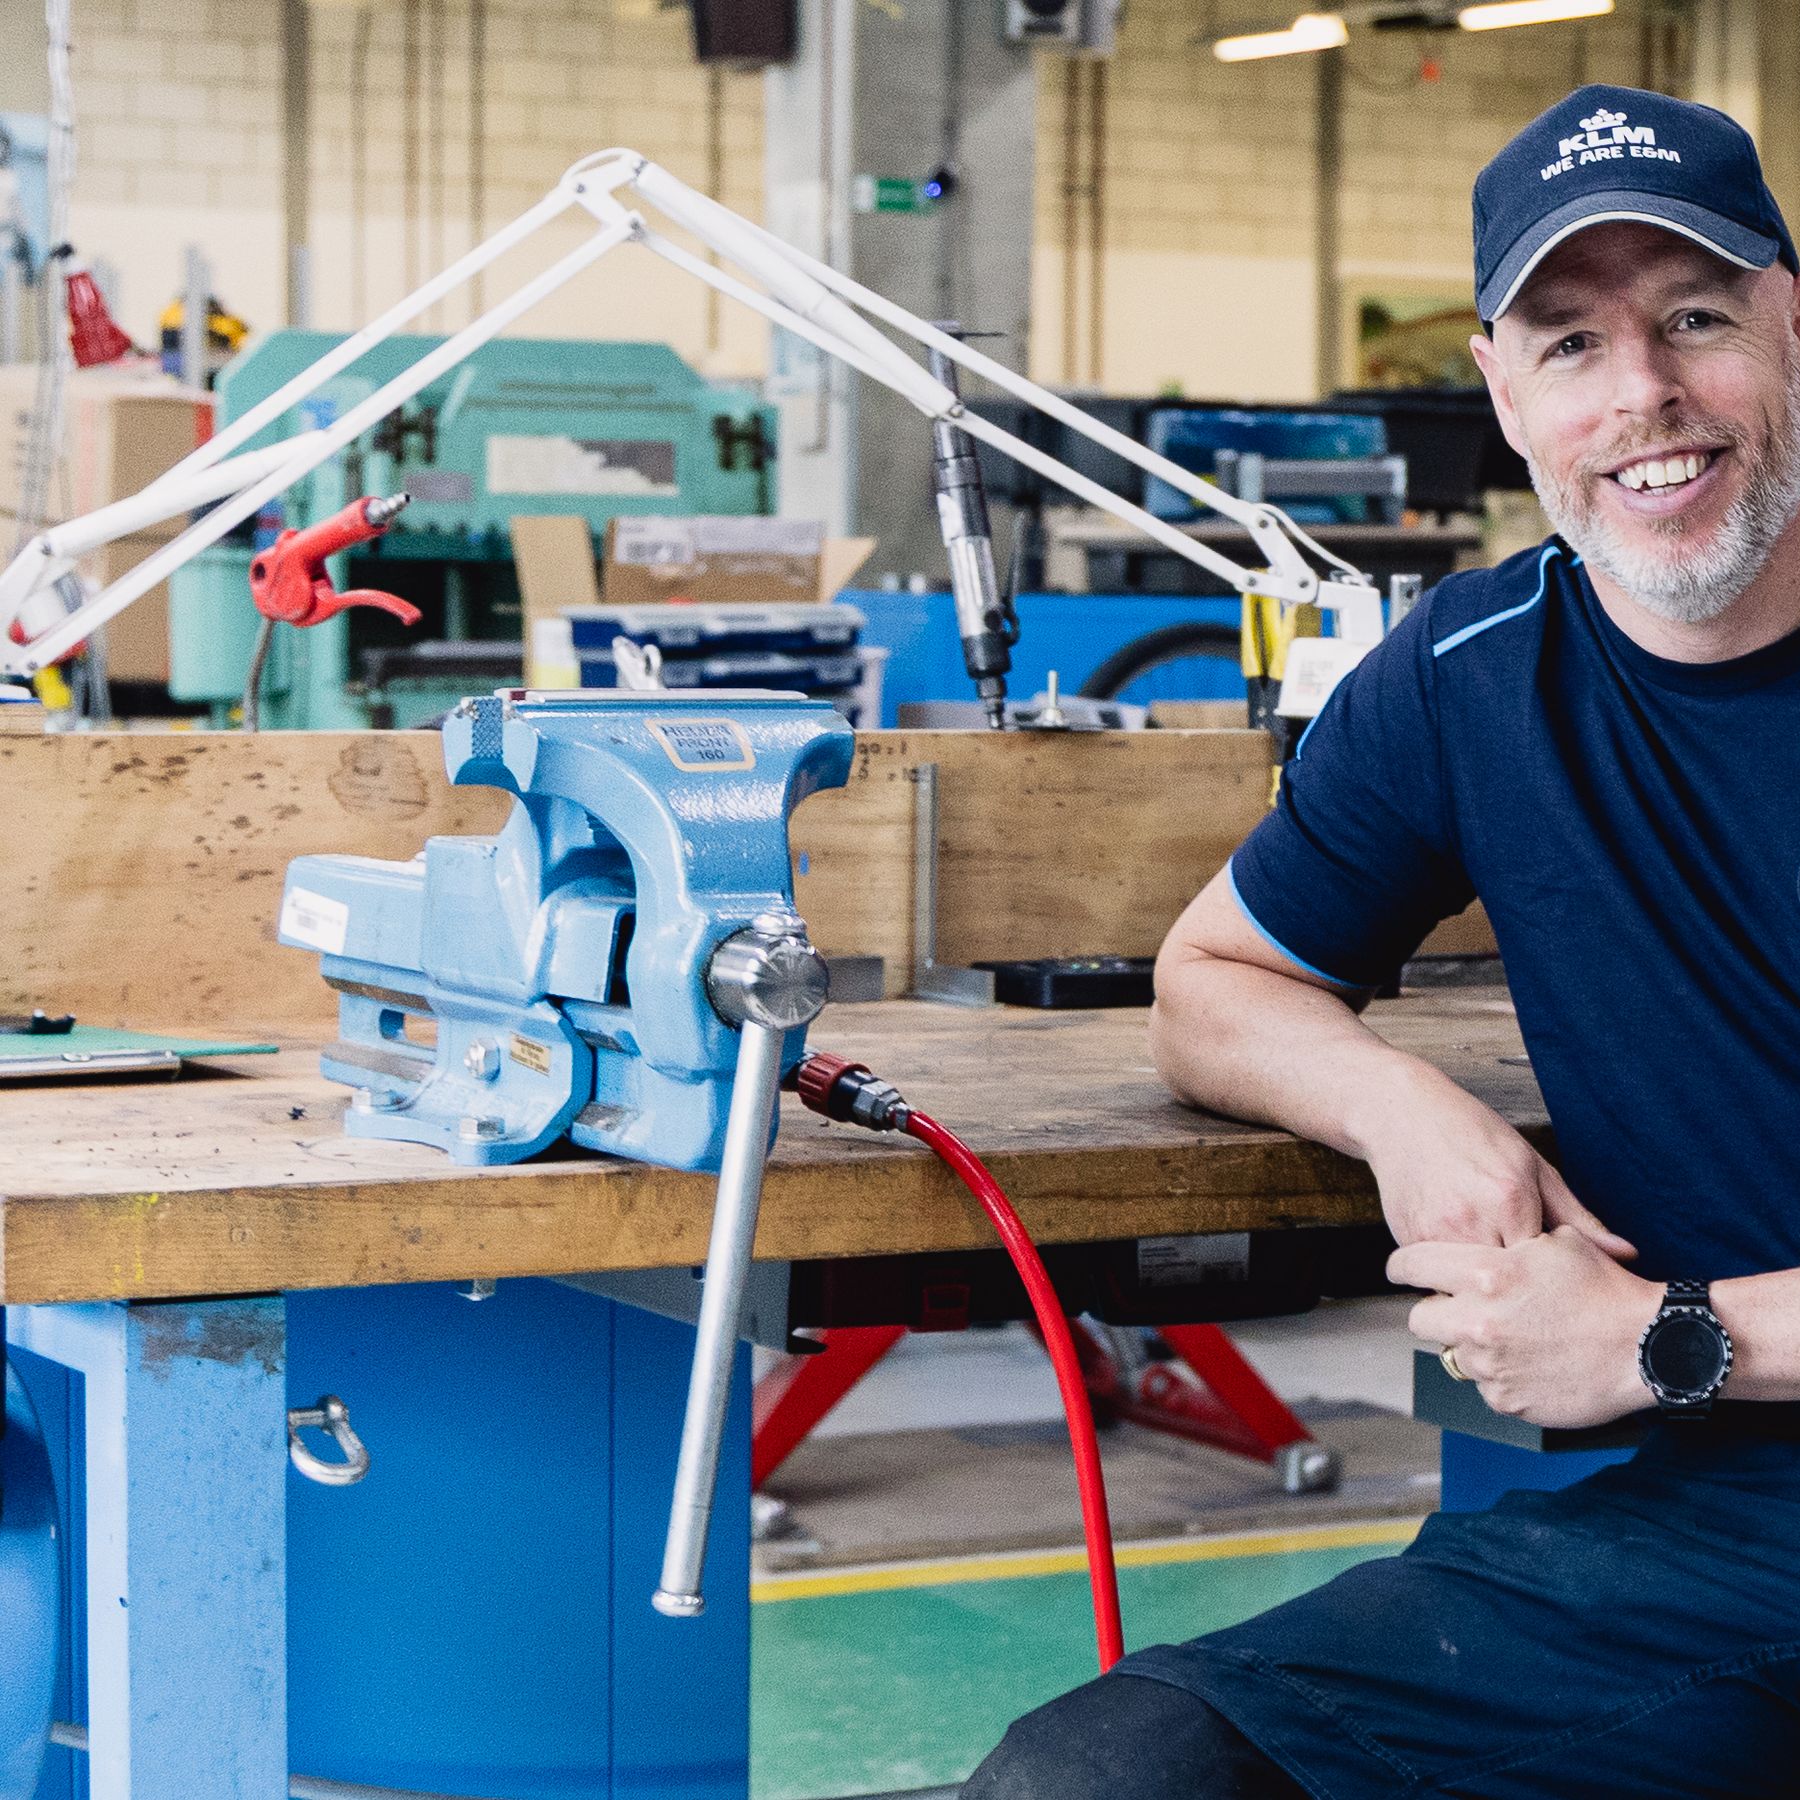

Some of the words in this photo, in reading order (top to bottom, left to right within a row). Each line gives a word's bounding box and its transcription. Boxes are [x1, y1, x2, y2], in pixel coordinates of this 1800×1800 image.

[1558, 126, 1656, 158] KLM
[1540, 155, 1575, 181] WE
[1579, 145, 1625, 166] ARE
[1629, 145, 1681, 164] E&M
[697, 749, 726, 761] 160
